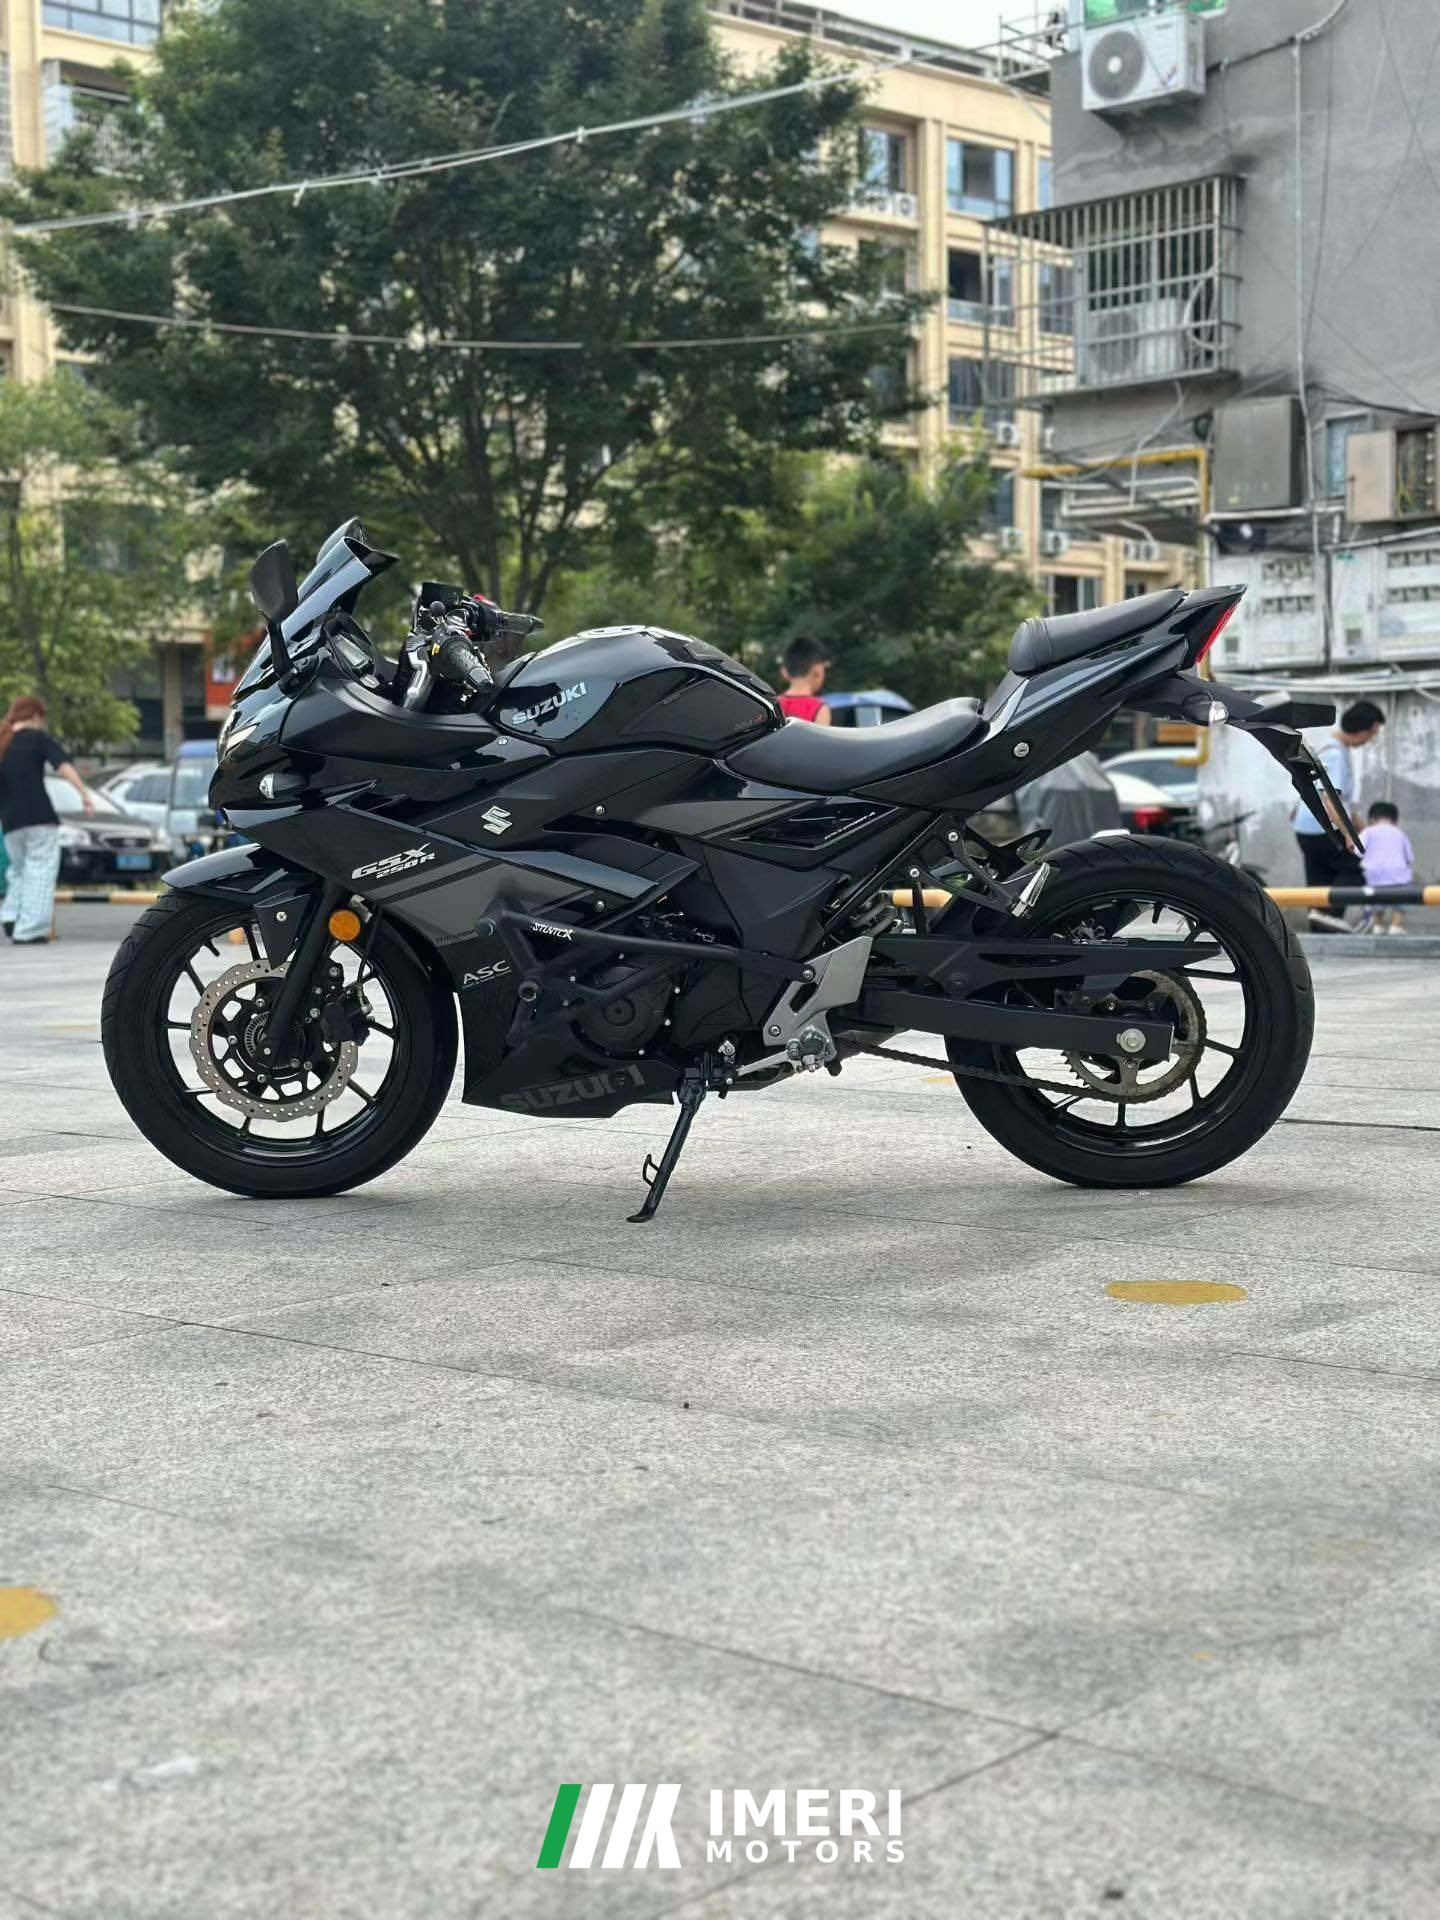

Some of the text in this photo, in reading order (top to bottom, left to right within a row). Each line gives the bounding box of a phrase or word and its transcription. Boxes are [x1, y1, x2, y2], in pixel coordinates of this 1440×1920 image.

[512, 682, 587, 725] SUZUKI
[351, 842, 432, 880] GSX
[376, 852, 436, 879] 250R
[463, 960, 510, 985] ASC
